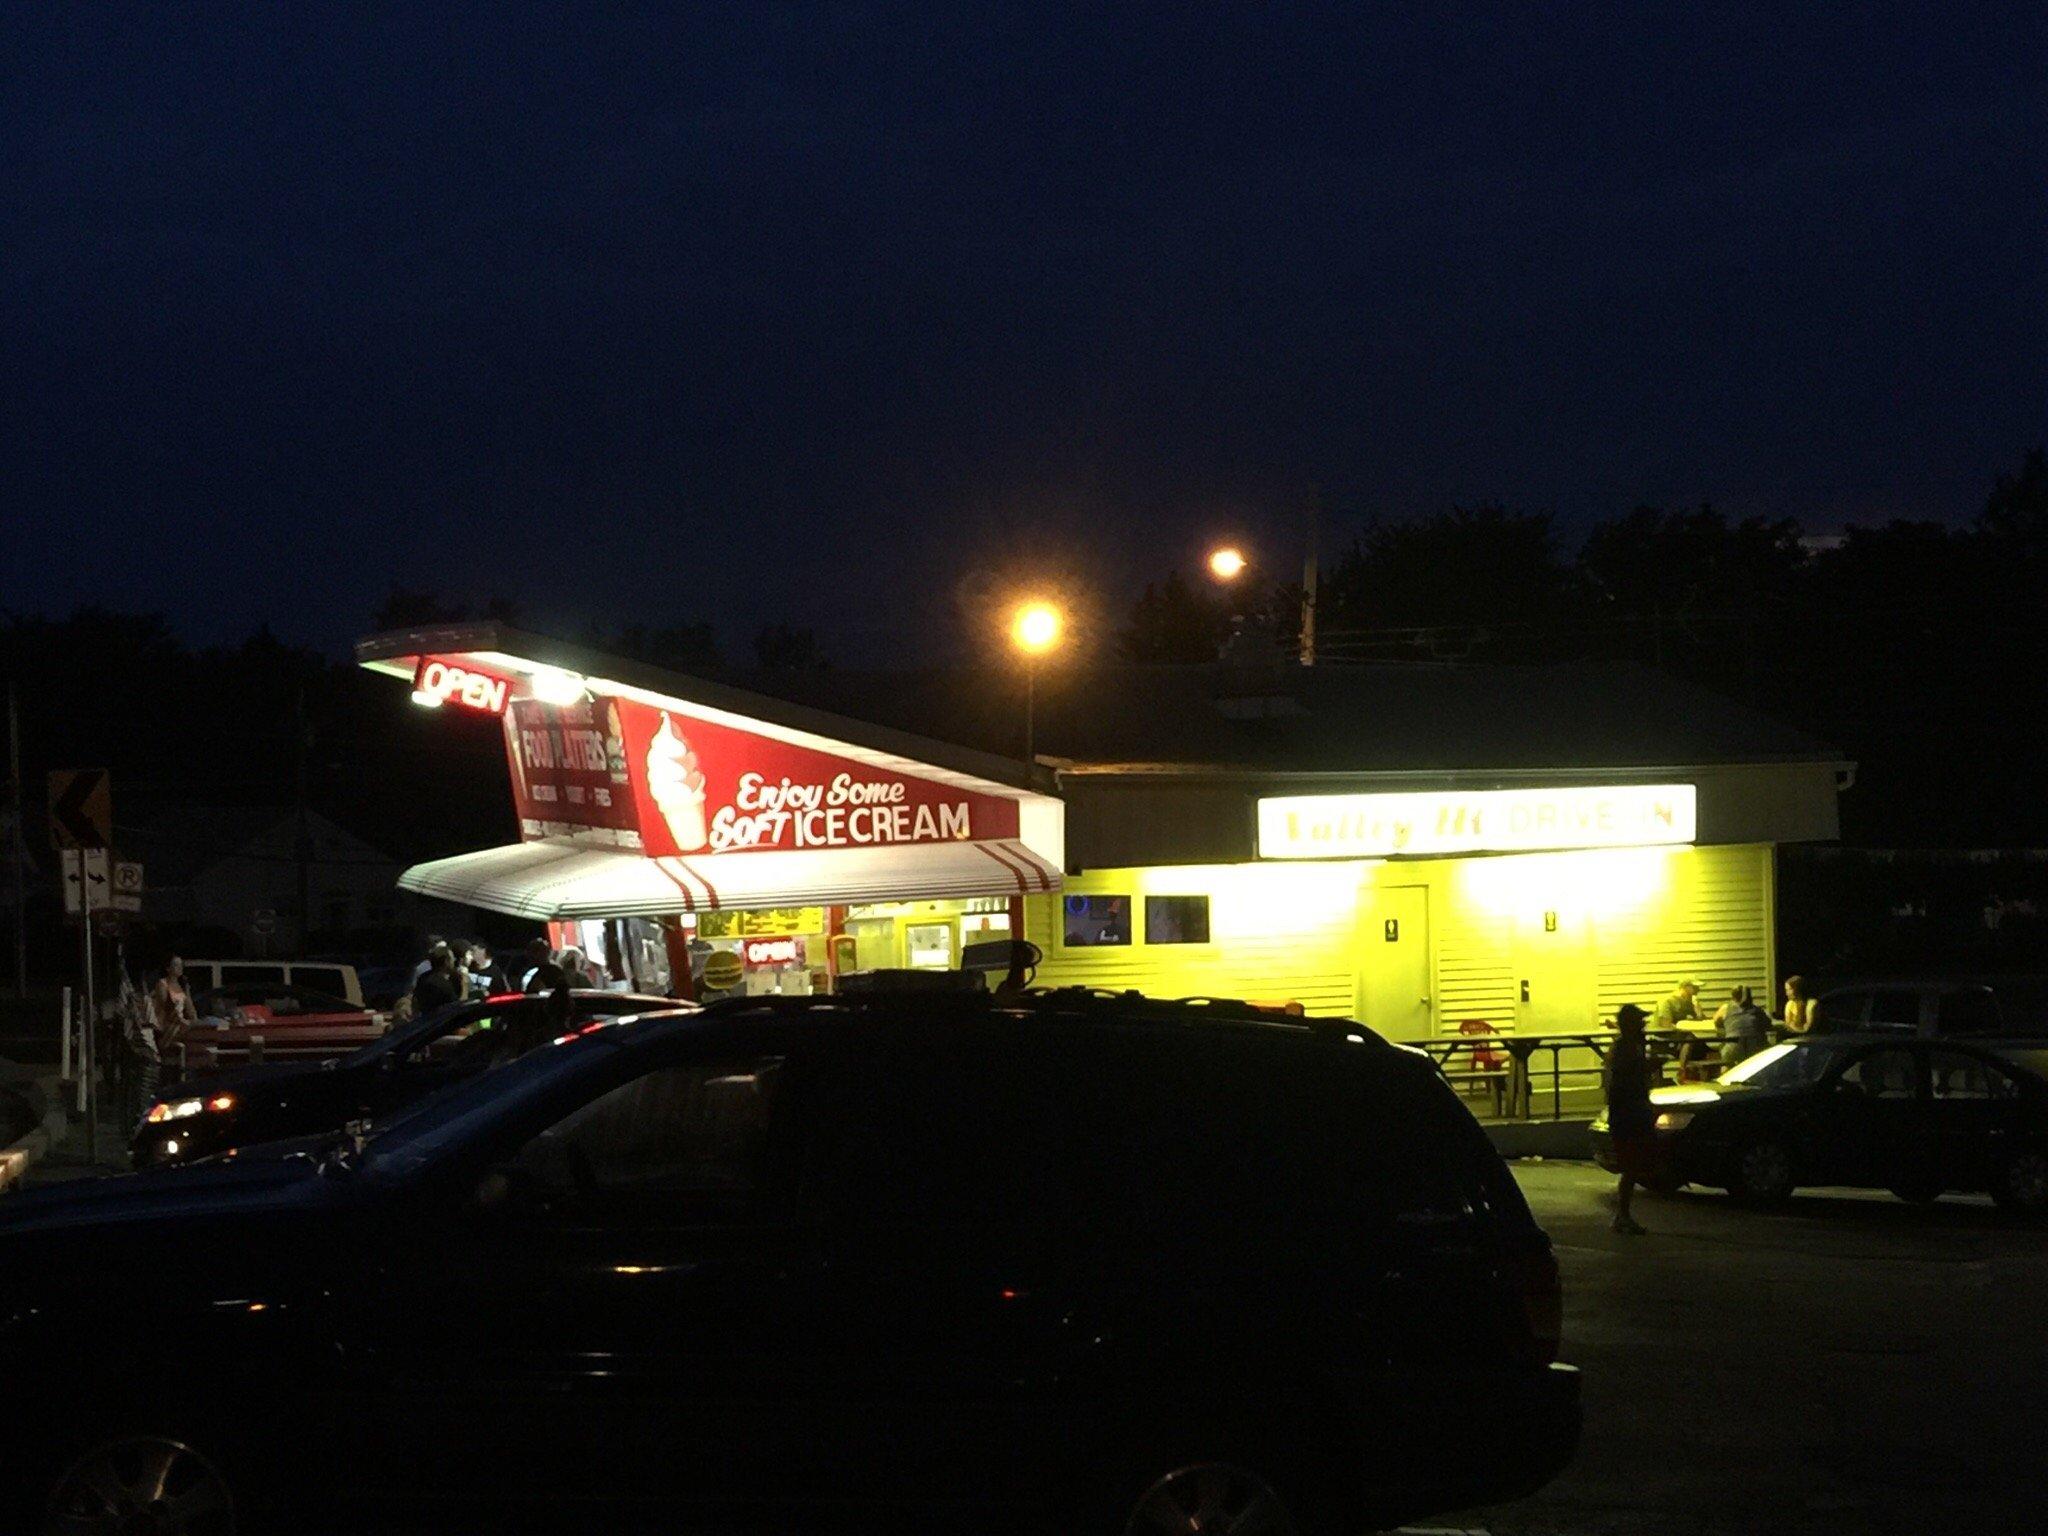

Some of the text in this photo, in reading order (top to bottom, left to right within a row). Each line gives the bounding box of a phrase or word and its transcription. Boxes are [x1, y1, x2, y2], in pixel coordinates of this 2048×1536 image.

[423, 663, 506, 712] OPEN
[737, 773, 905, 812] Enjoy Some
[794, 808, 847, 847] ICE
[849, 802, 971, 843] CREAM
[748, 940, 797, 963] OPEN
